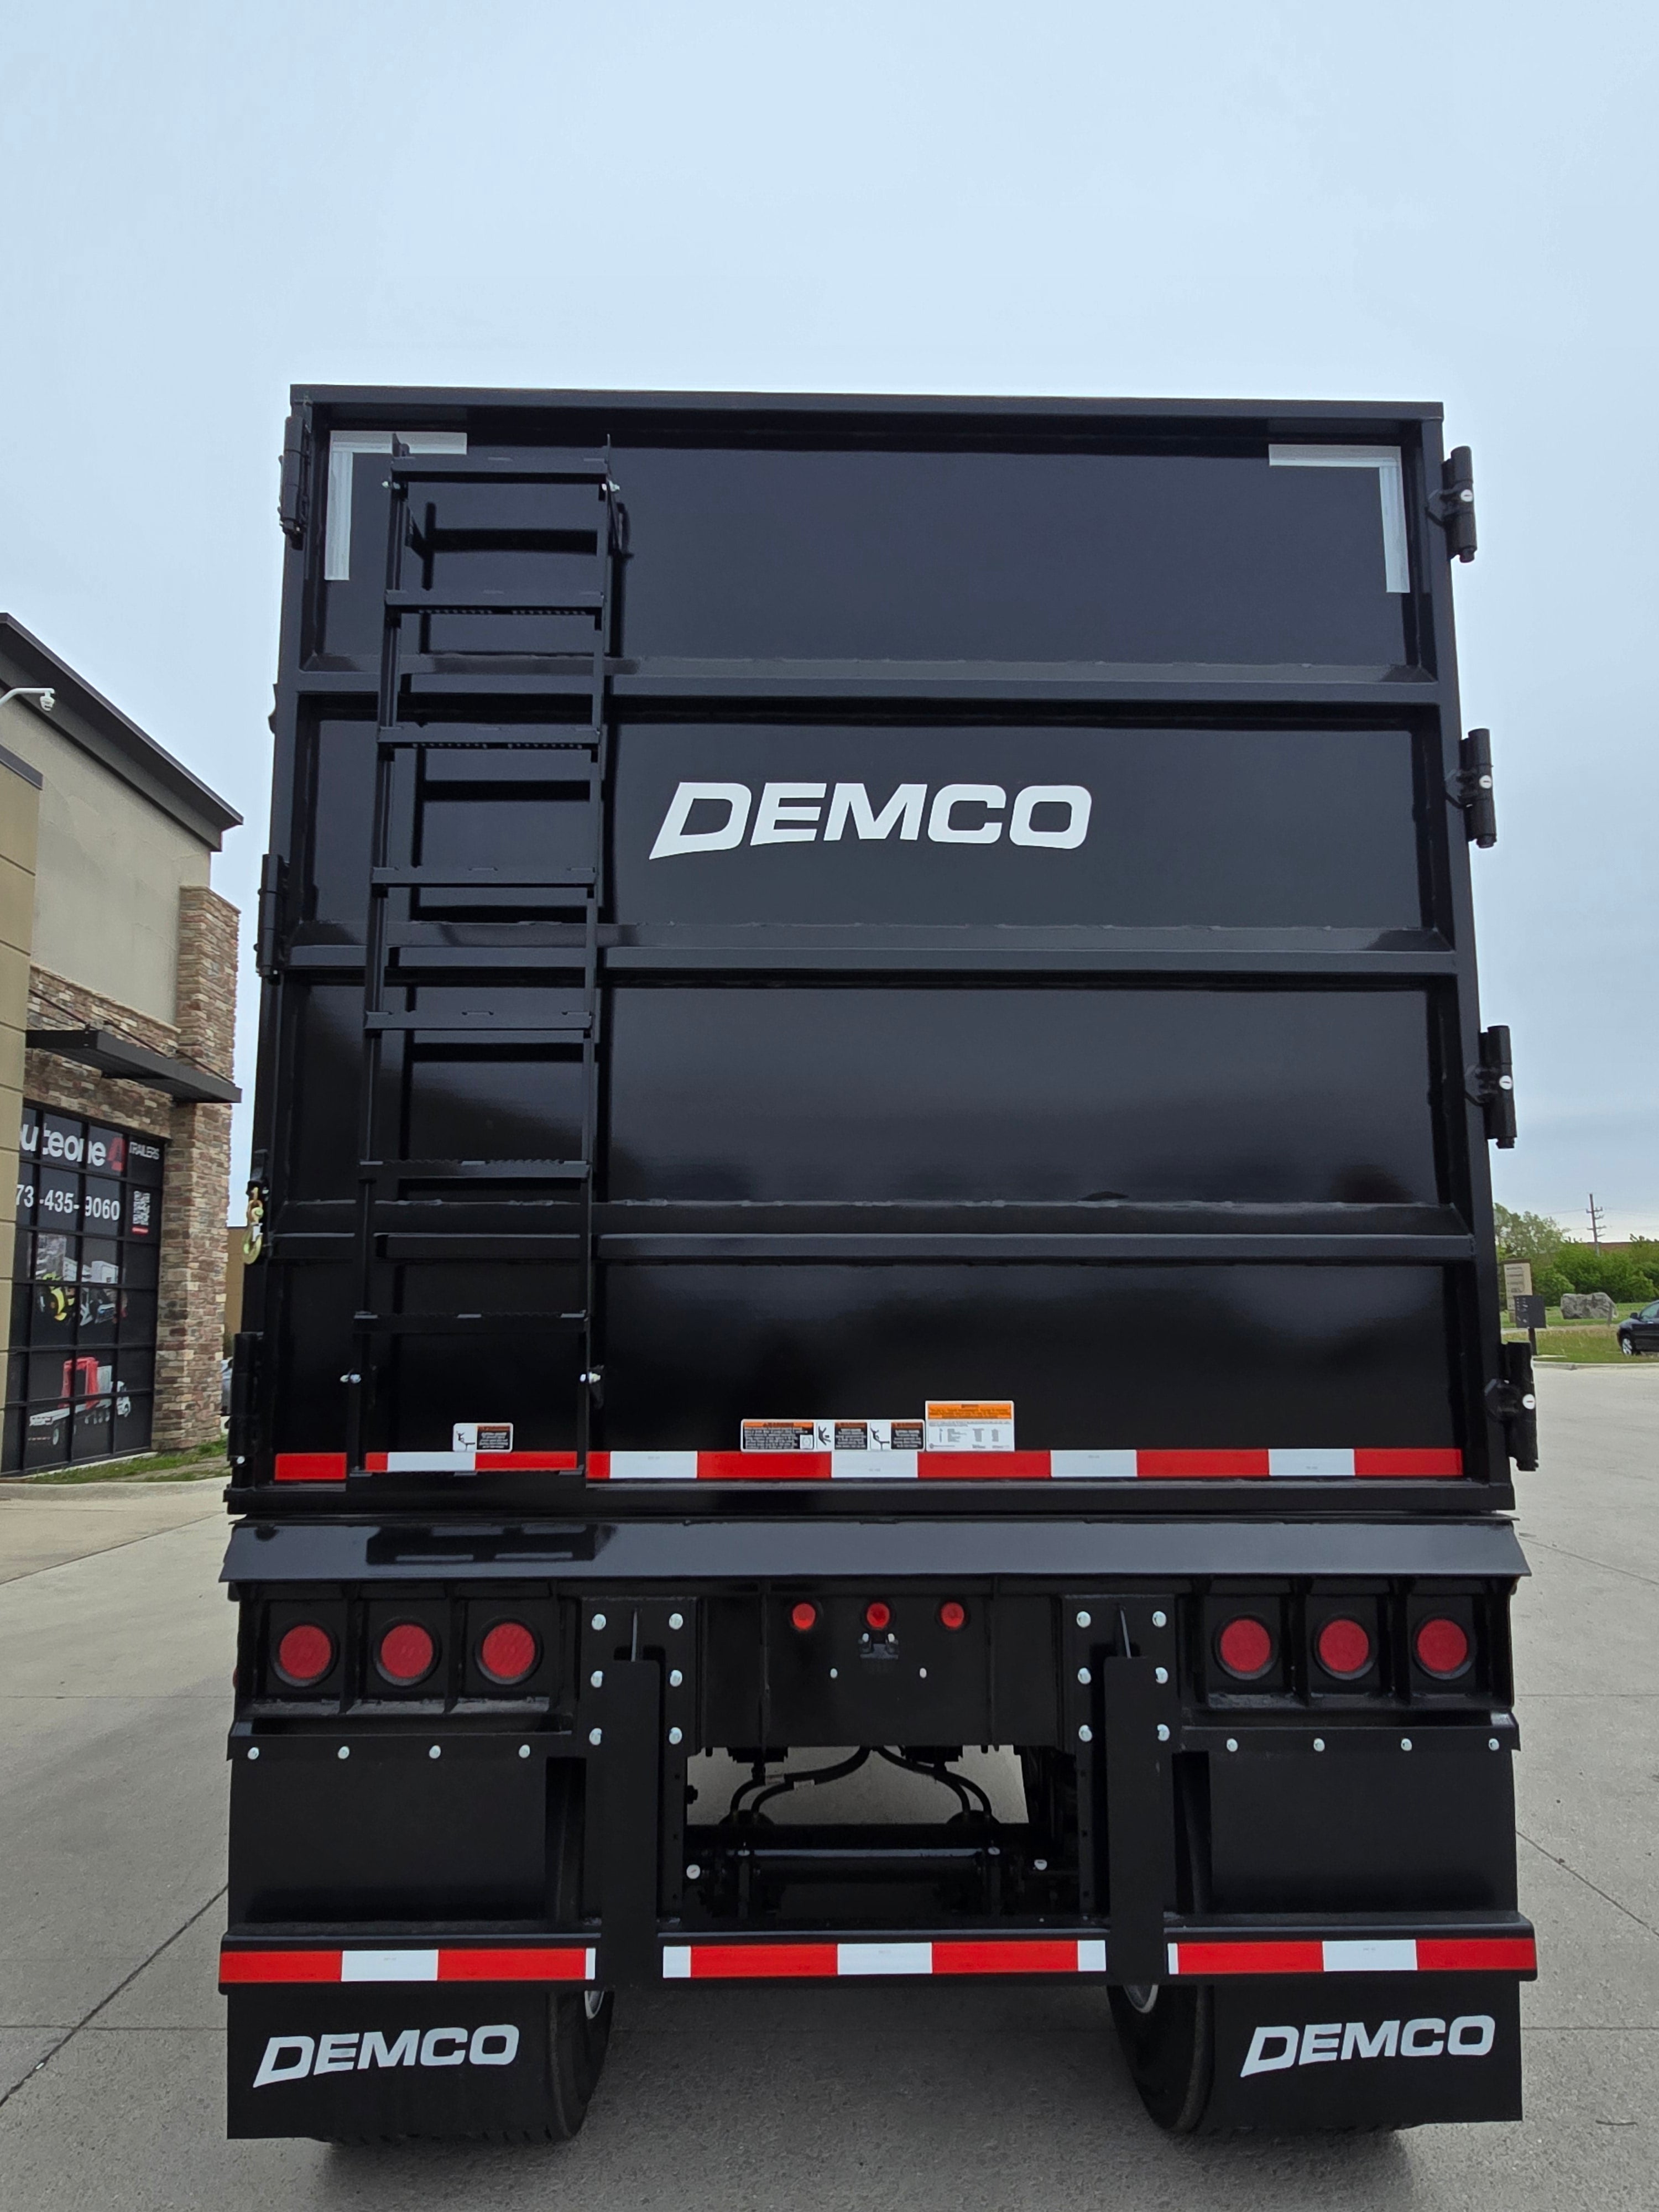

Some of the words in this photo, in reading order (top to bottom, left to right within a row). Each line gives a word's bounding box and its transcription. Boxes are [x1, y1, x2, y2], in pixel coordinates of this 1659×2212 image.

[649, 782, 1092, 860] DEMCO
[20, 1123, 106, 1166] uteone
[253, 2024, 519, 2088] DEMCO
[1240, 2015, 1495, 2078] DEMCO
